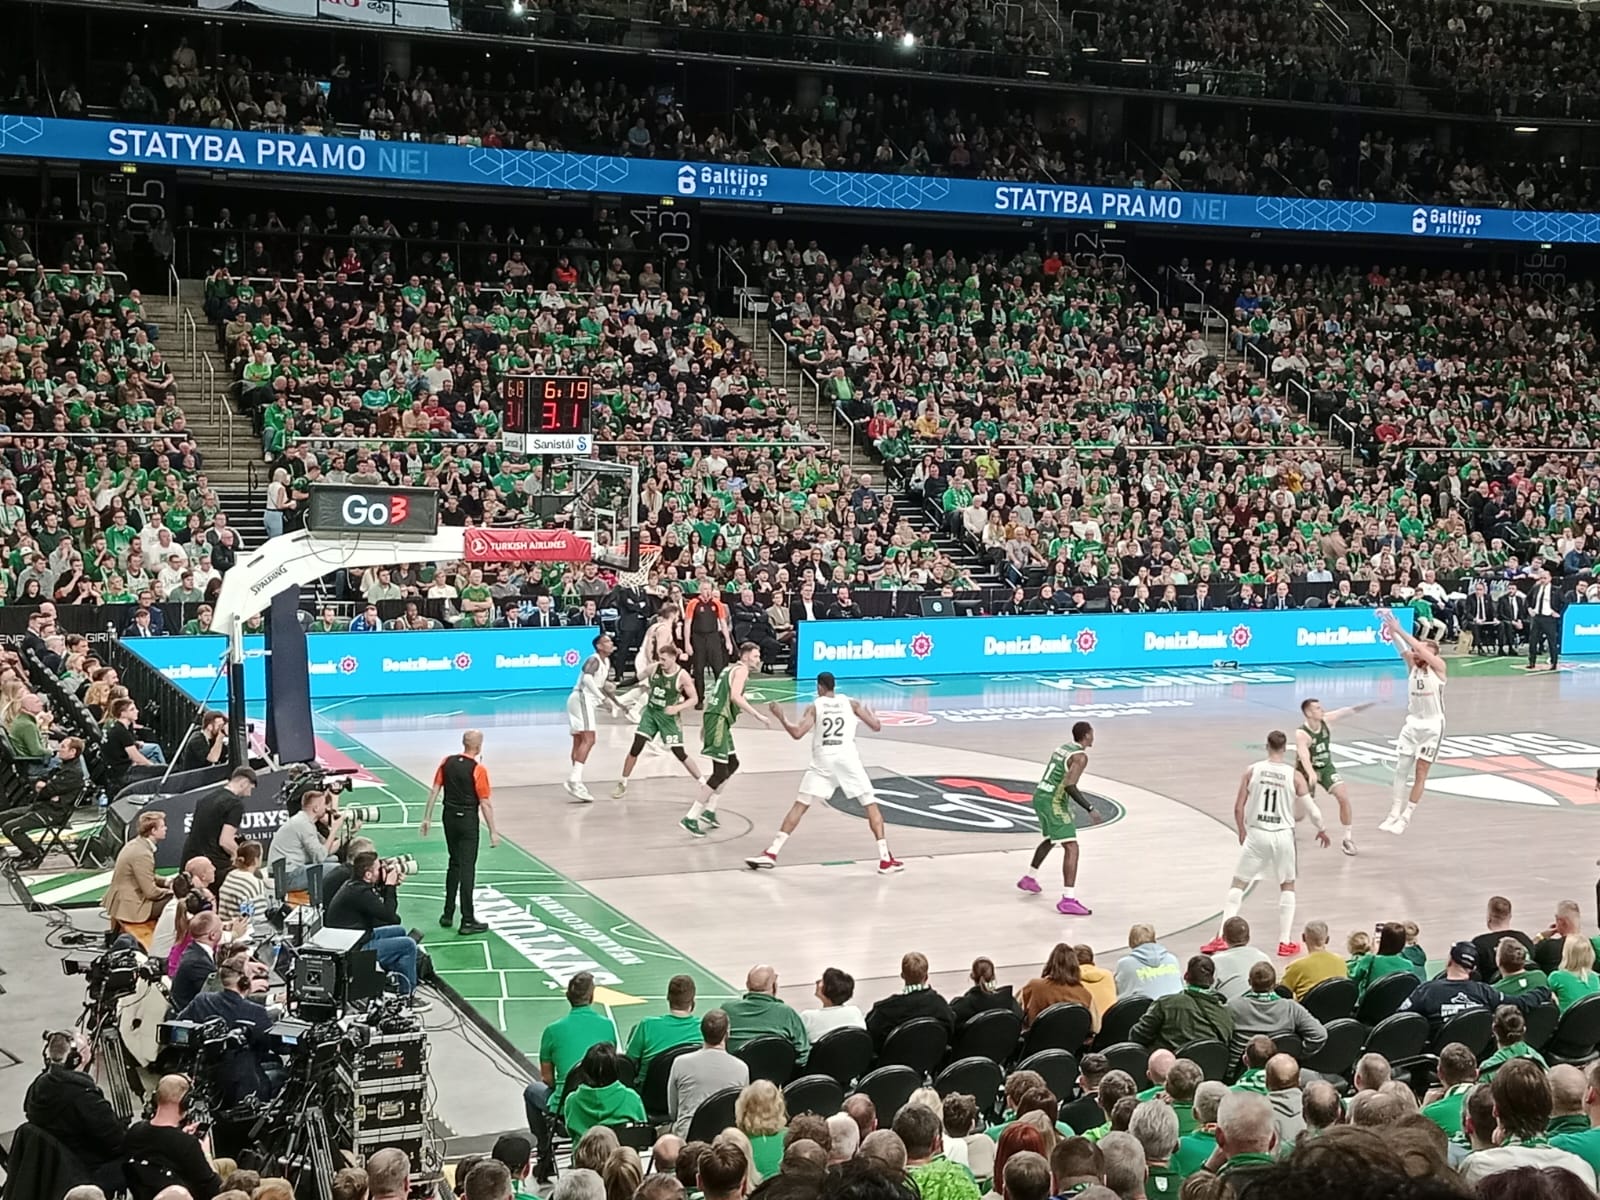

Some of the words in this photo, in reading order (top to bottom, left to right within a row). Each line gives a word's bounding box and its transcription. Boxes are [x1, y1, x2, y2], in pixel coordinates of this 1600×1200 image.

[107, 128, 246, 164] STATYBA
[256, 138, 366, 171] PRAMO
[701, 166, 768, 188] Baltijos
[994, 186, 1093, 215] STATYBA
[1101, 192, 1183, 219] PRAMO
[544, 381, 588, 399] 6:19
[541, 402, 579, 429] 3.1
[342, 494, 408, 525] Go3
[491, 541, 527, 551] TURKISH
[529, 540, 567, 550] AIRLINES
[250, 564, 288, 596] SPALDING
[984, 634, 1073, 656] DenizBank
[1144, 630, 1228, 650] DenizBank
[1297, 625, 1377, 646] DenizBank
[495, 653, 562, 668] DenizBank
[813, 639, 907, 661] DenizBank
[382, 656, 452, 672] DenizBank
[822, 716, 845, 739] 22
[1264, 788, 1277, 813] 11
